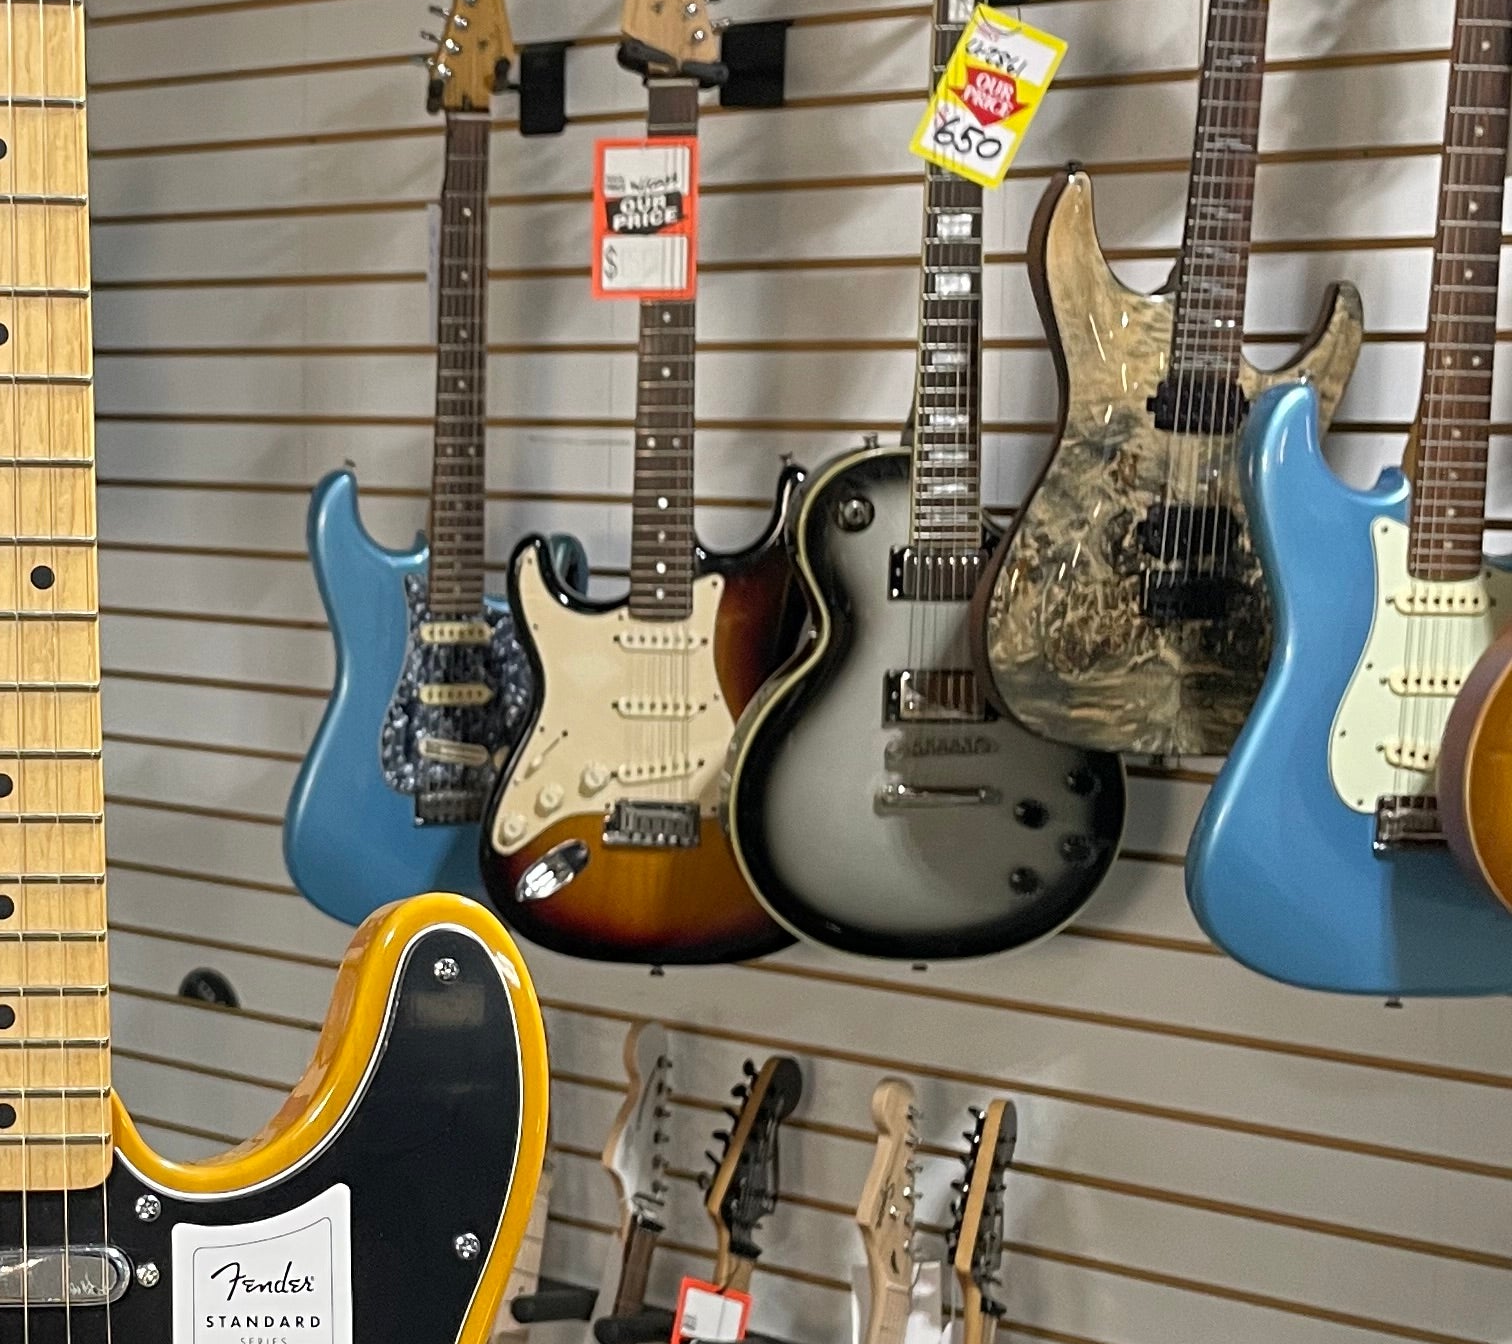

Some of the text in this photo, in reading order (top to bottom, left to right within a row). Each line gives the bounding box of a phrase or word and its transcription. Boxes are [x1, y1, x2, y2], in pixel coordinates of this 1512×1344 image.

[974, 71, 1015, 99] OUR
[619, 194, 667, 215] OUR
[611, 206, 678, 233] PRICE
[604, 244, 618, 280] $
[210, 1260, 315, 1302] Fender
[205, 1315, 322, 1329] STANDARD
